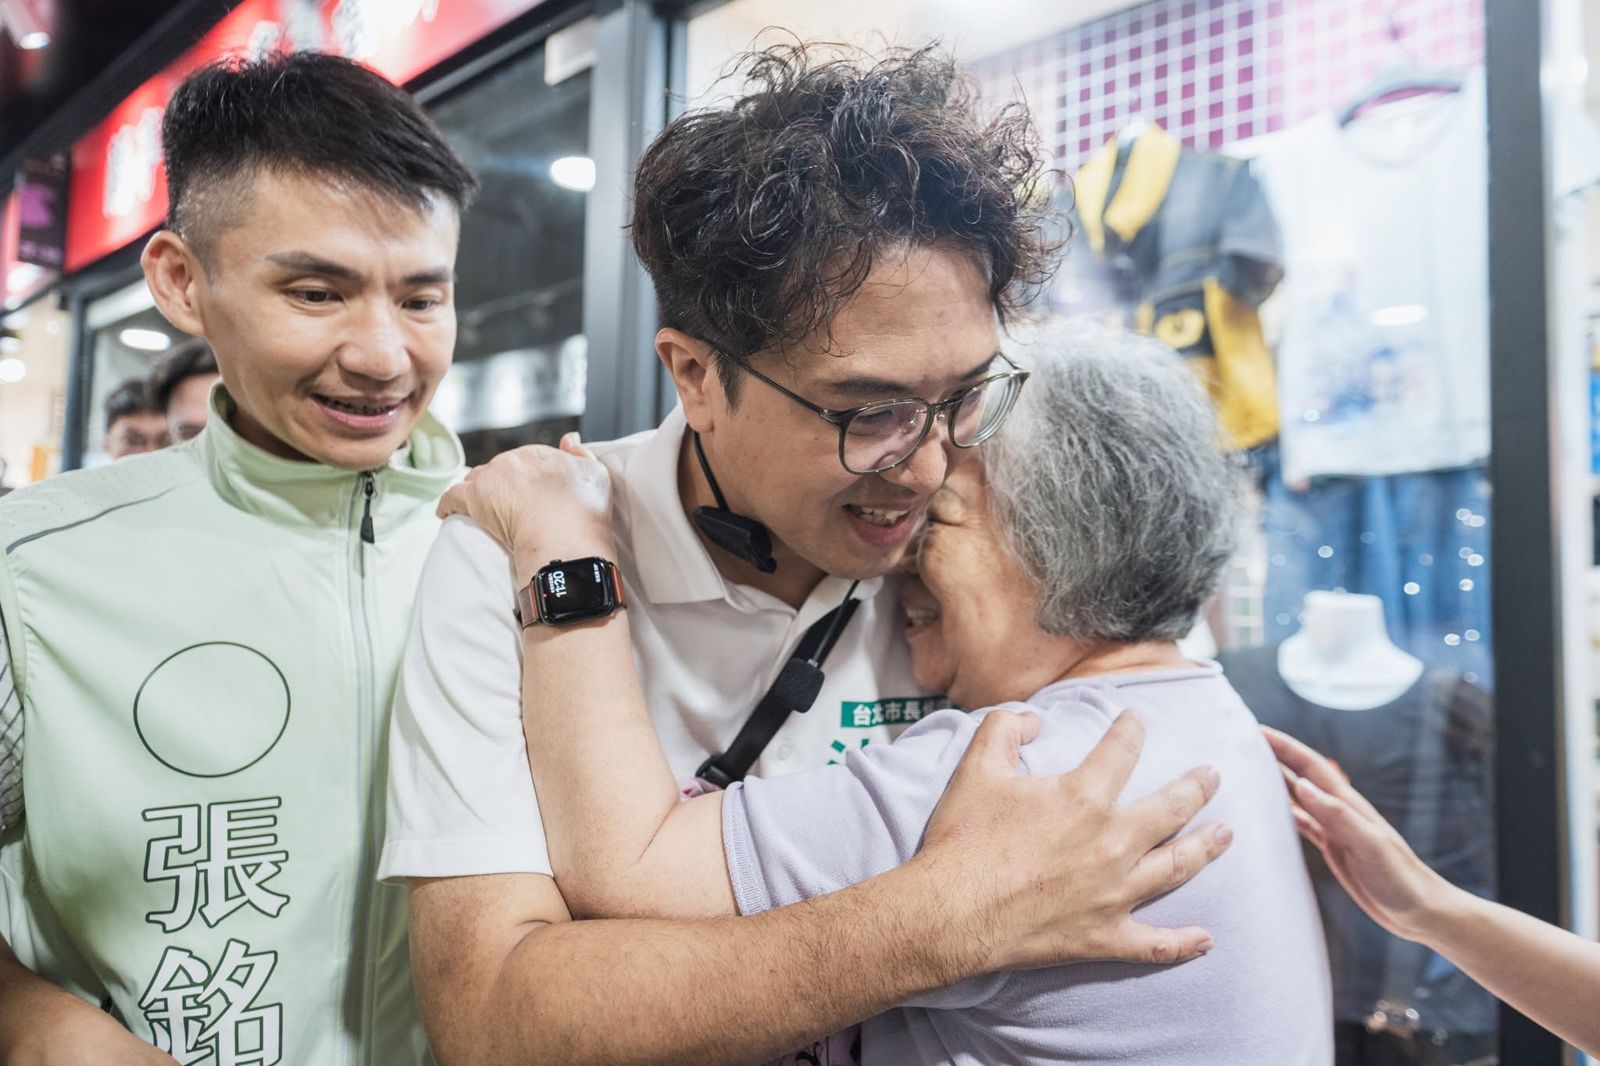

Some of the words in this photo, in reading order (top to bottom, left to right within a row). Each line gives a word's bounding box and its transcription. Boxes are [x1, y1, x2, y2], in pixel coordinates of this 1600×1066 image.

[552, 570, 567, 598] 11:20
[852, 699, 950, 726] 台北市長
[138, 796, 290, 1066] 張銘
